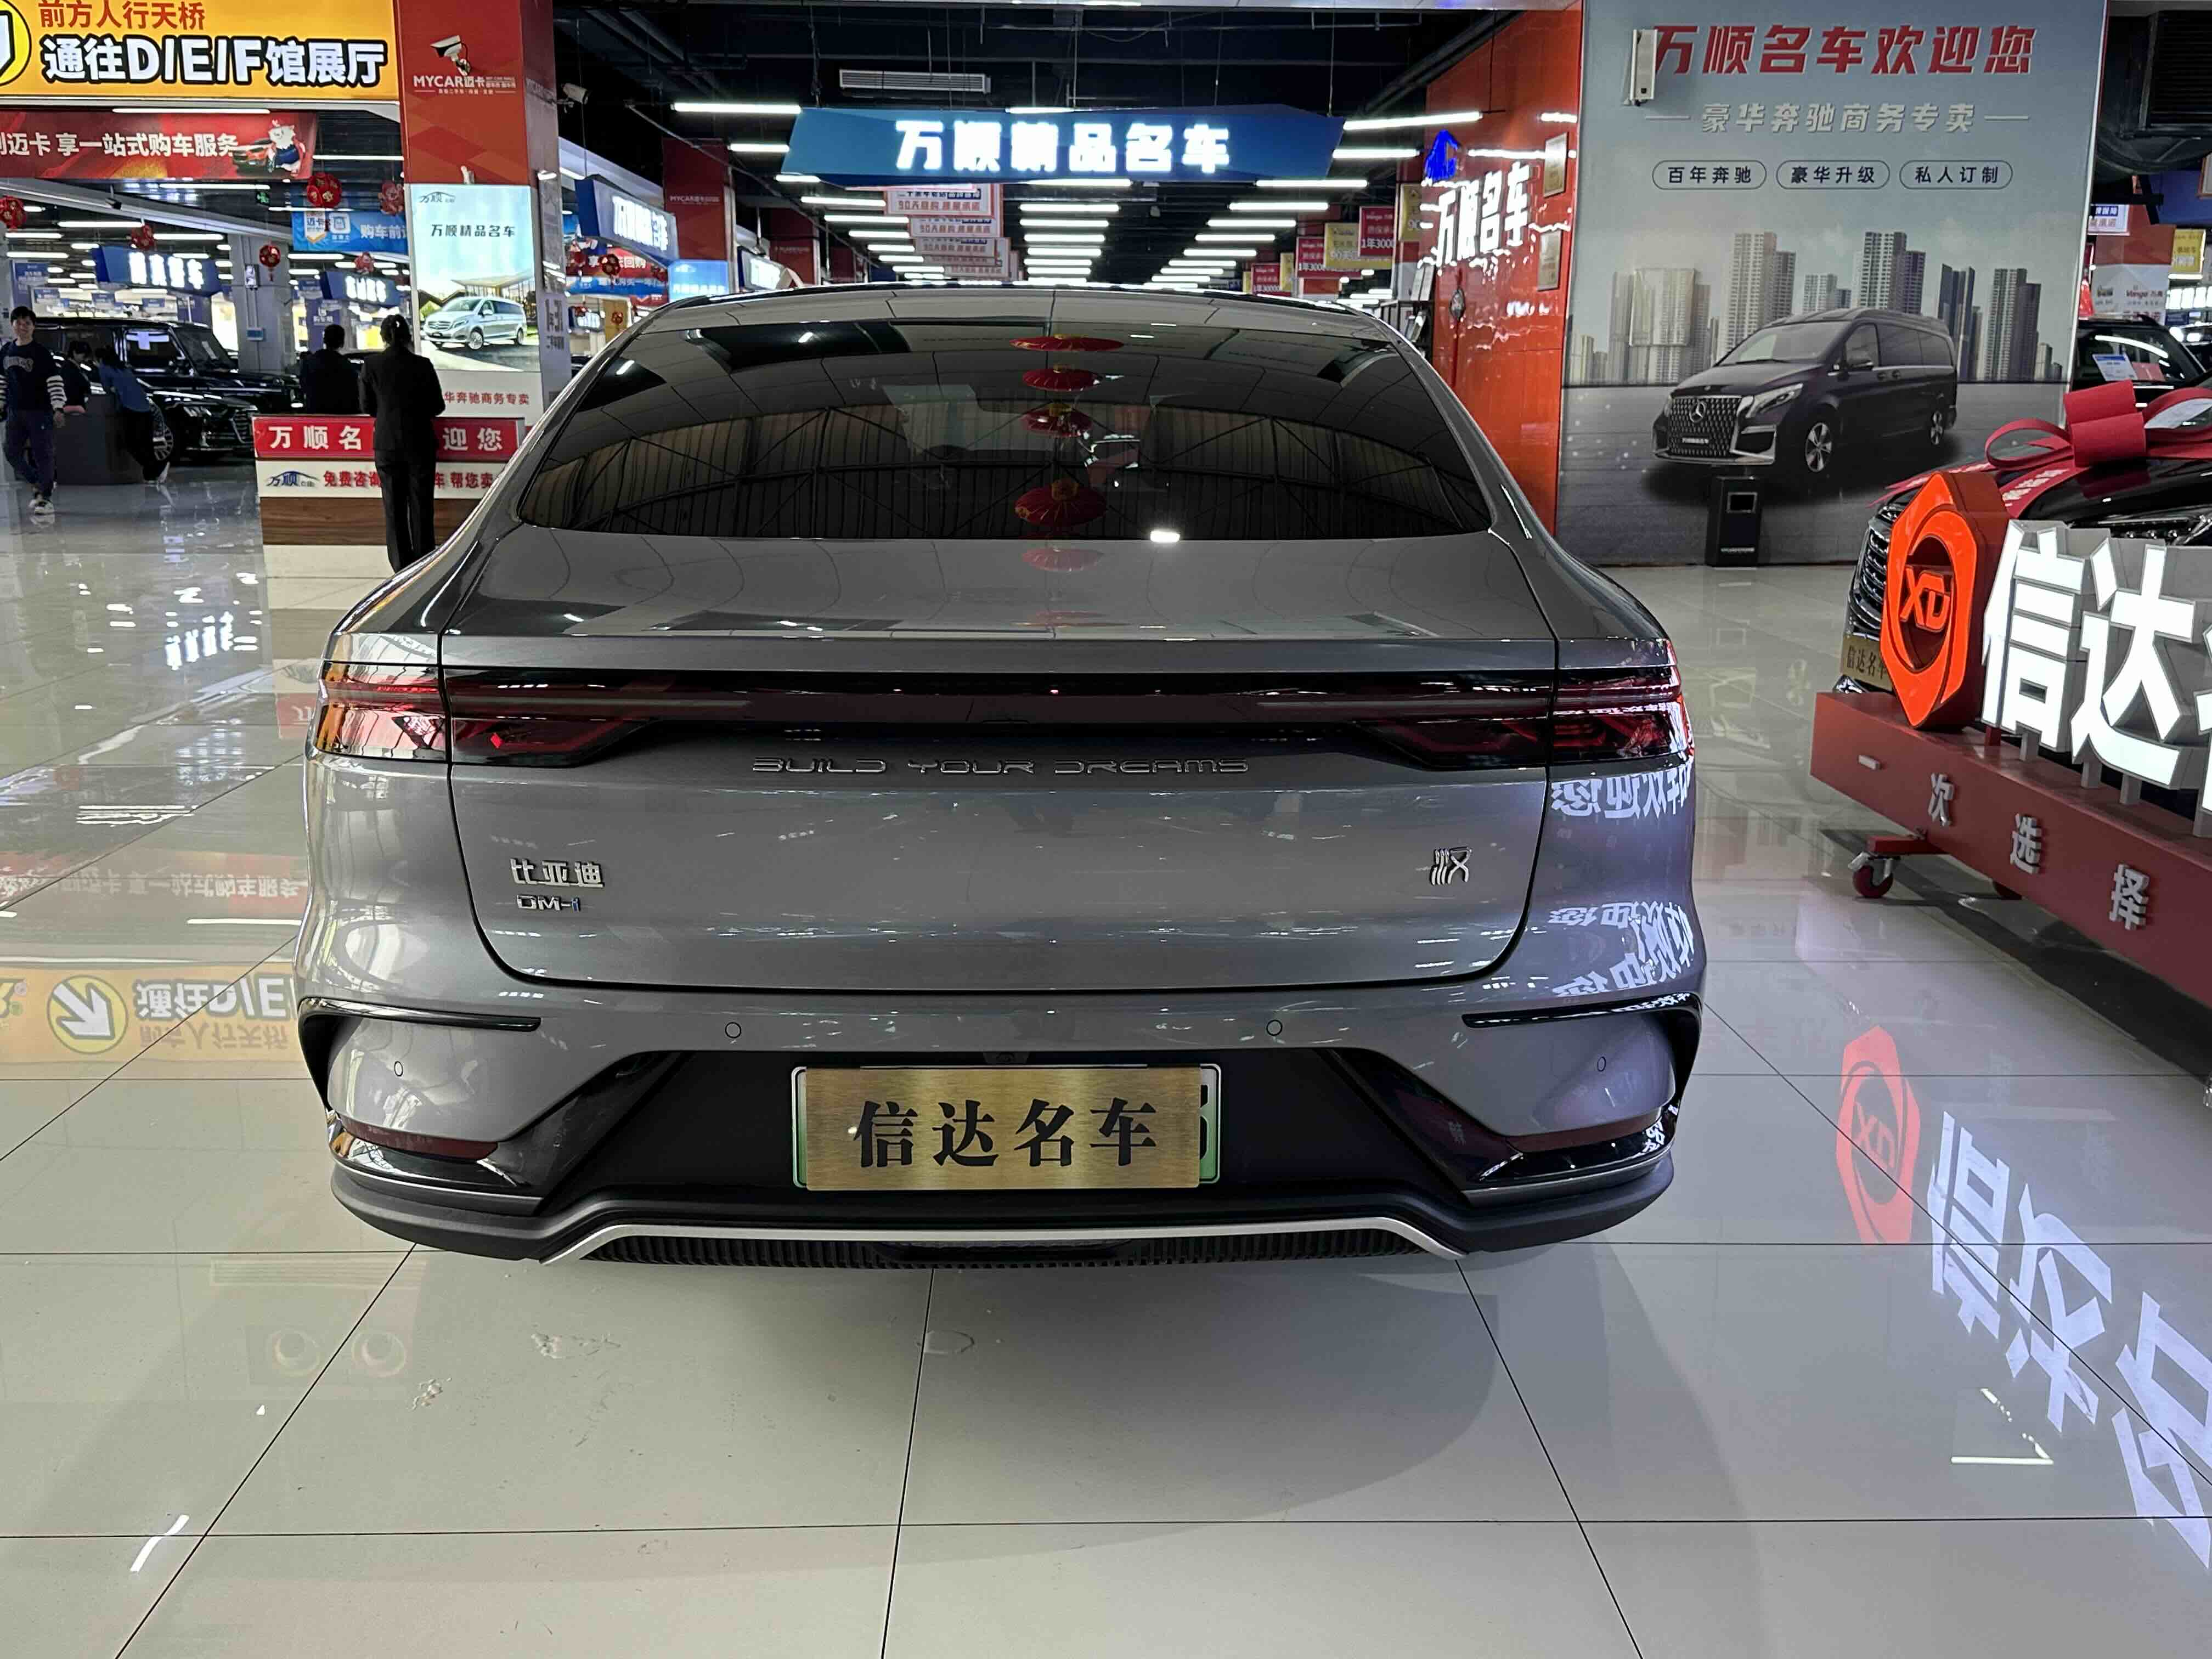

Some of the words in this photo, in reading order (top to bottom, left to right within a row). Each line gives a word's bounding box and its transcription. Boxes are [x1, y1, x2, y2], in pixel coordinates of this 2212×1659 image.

[39, 1, 205, 30] 前方人行天桥
[43, 36, 385, 84] 通往D/E/F馆展厅
[1652, 24, 2036, 75] 万顺名车欢迎您
[1701, 103, 1975, 133] 豪华奔驰商务专卖
[55, 133, 238, 157] 享一站式购车服务
[895, 120, 1229, 173] 万顺精品名车
[1668, 166, 1752, 184] 百年奔驰
[1791, 166, 1876, 184] 豪华升级
[1914, 166, 1999, 184] 私人订制
[1435, 161, 1531, 267] 万顺名车
[431, 224, 515, 237] 万顺精品名车
[444, 391, 529, 404] 华奔驰商务专卖
[268, 425, 362, 450] 万顺名
[443, 427, 503, 452] 迎您
[1982, 520, 2212, 814] 信达
[752, 757, 887, 774] BUILD
[907, 758, 1035, 775] YOUR
[1053, 758, 1250, 775] DREAMS
[510, 857, 604, 888] 比亚迪
[516, 894, 580, 913] DM-i
[853, 1097, 1156, 1168] 信达名车
